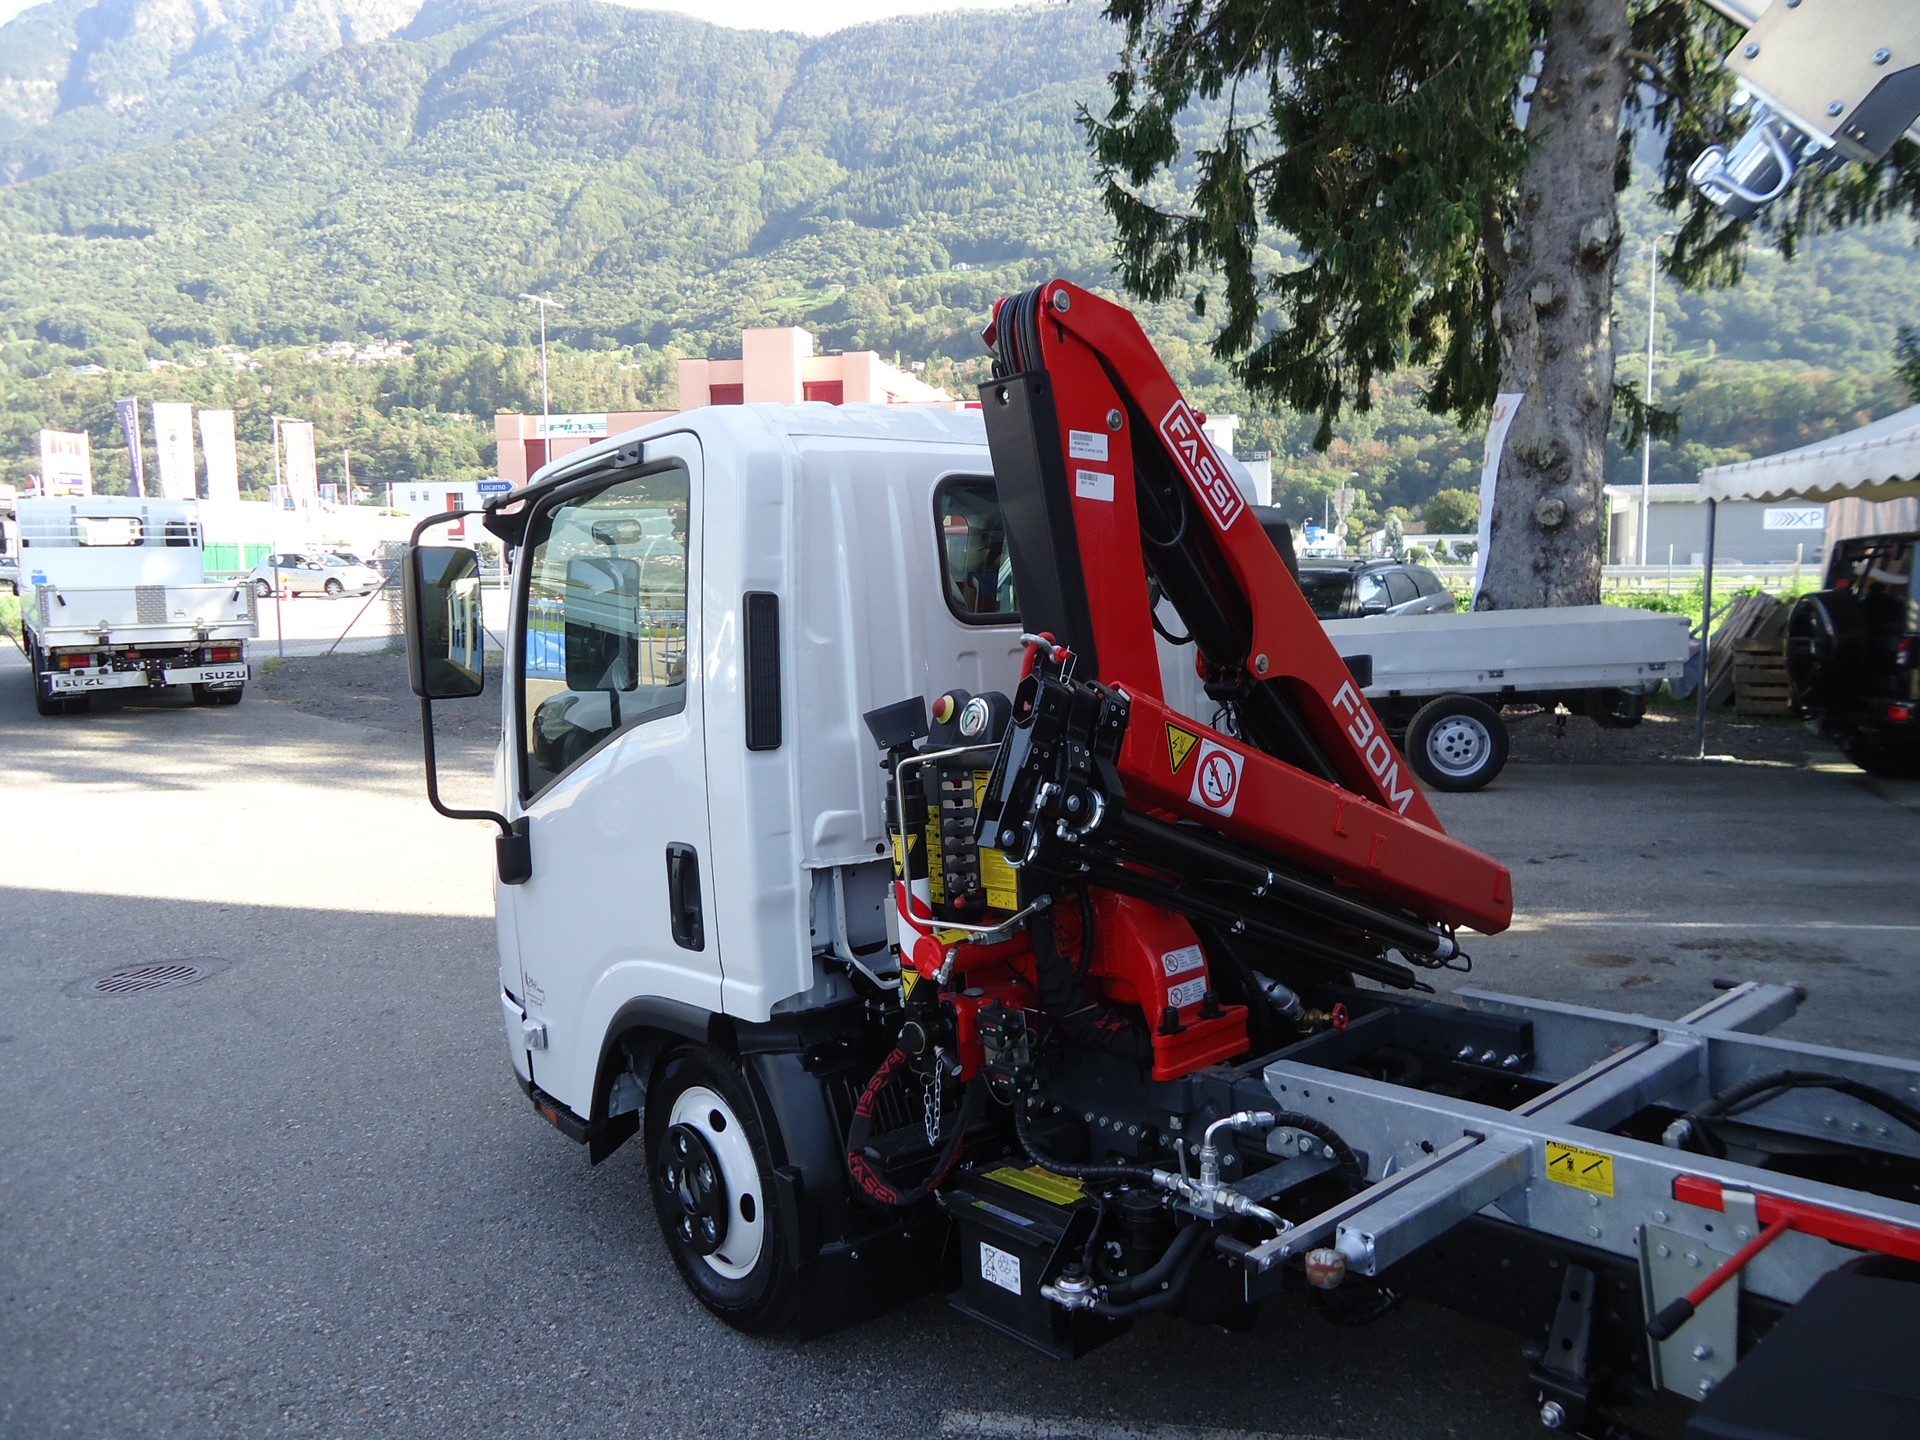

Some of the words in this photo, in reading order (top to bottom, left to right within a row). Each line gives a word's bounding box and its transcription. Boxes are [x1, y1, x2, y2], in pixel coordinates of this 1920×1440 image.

[1170, 414, 1235, 517] FASSI
[200, 671, 246, 681] ISUZU
[1332, 680, 1415, 815] F30M
[854, 1047, 908, 1118] FASSI
[848, 1152, 898, 1206] FASSI
[986, 1269, 997, 1282] Pb
